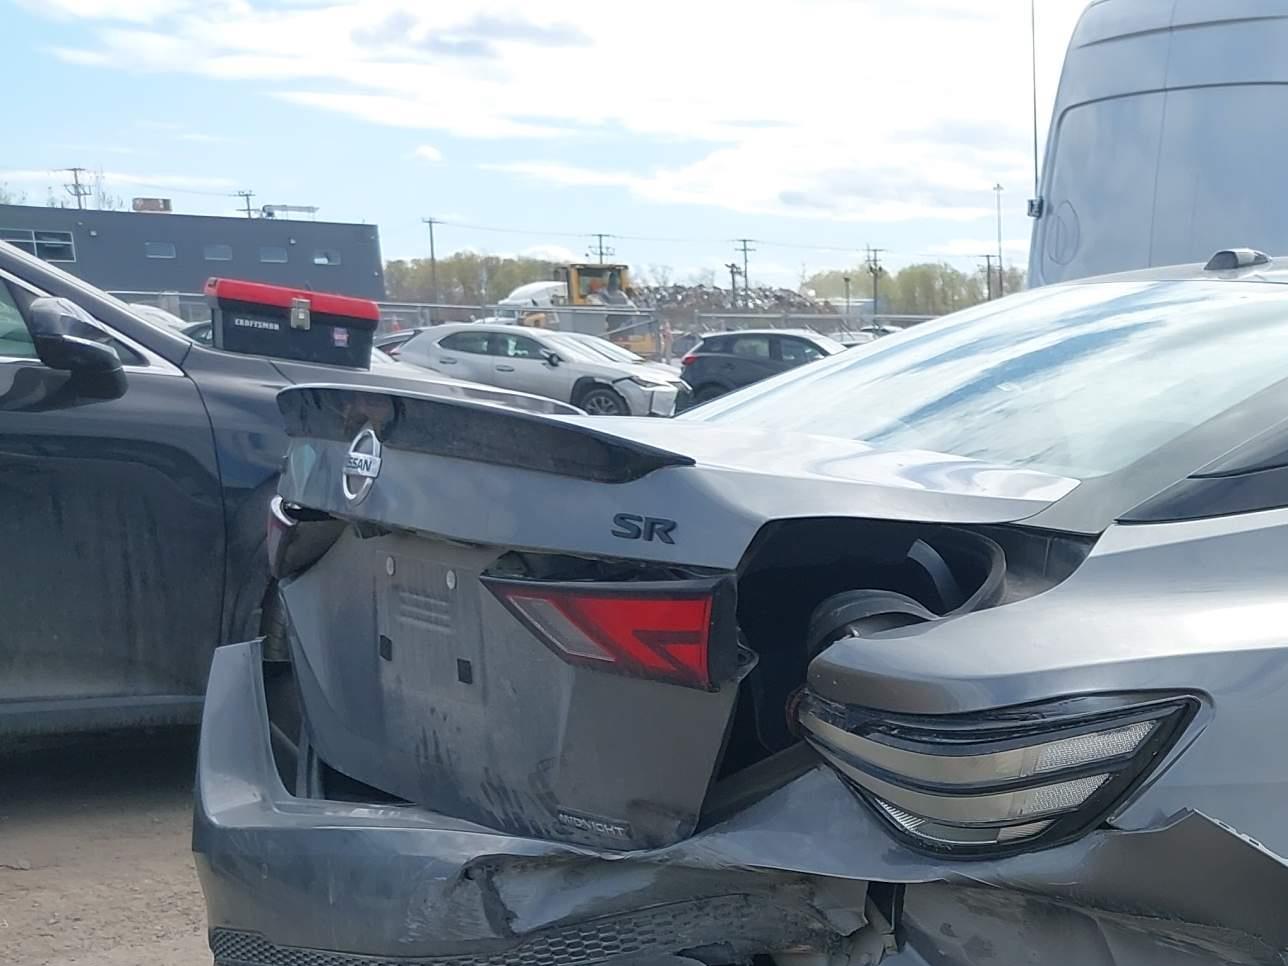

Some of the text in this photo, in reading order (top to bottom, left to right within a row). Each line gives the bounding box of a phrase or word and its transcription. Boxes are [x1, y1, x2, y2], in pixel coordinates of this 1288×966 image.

[234, 318, 280, 331] CRAFTSMAN
[610, 512, 678, 545] SR
[559, 813, 625, 837] MIDNIGHT
